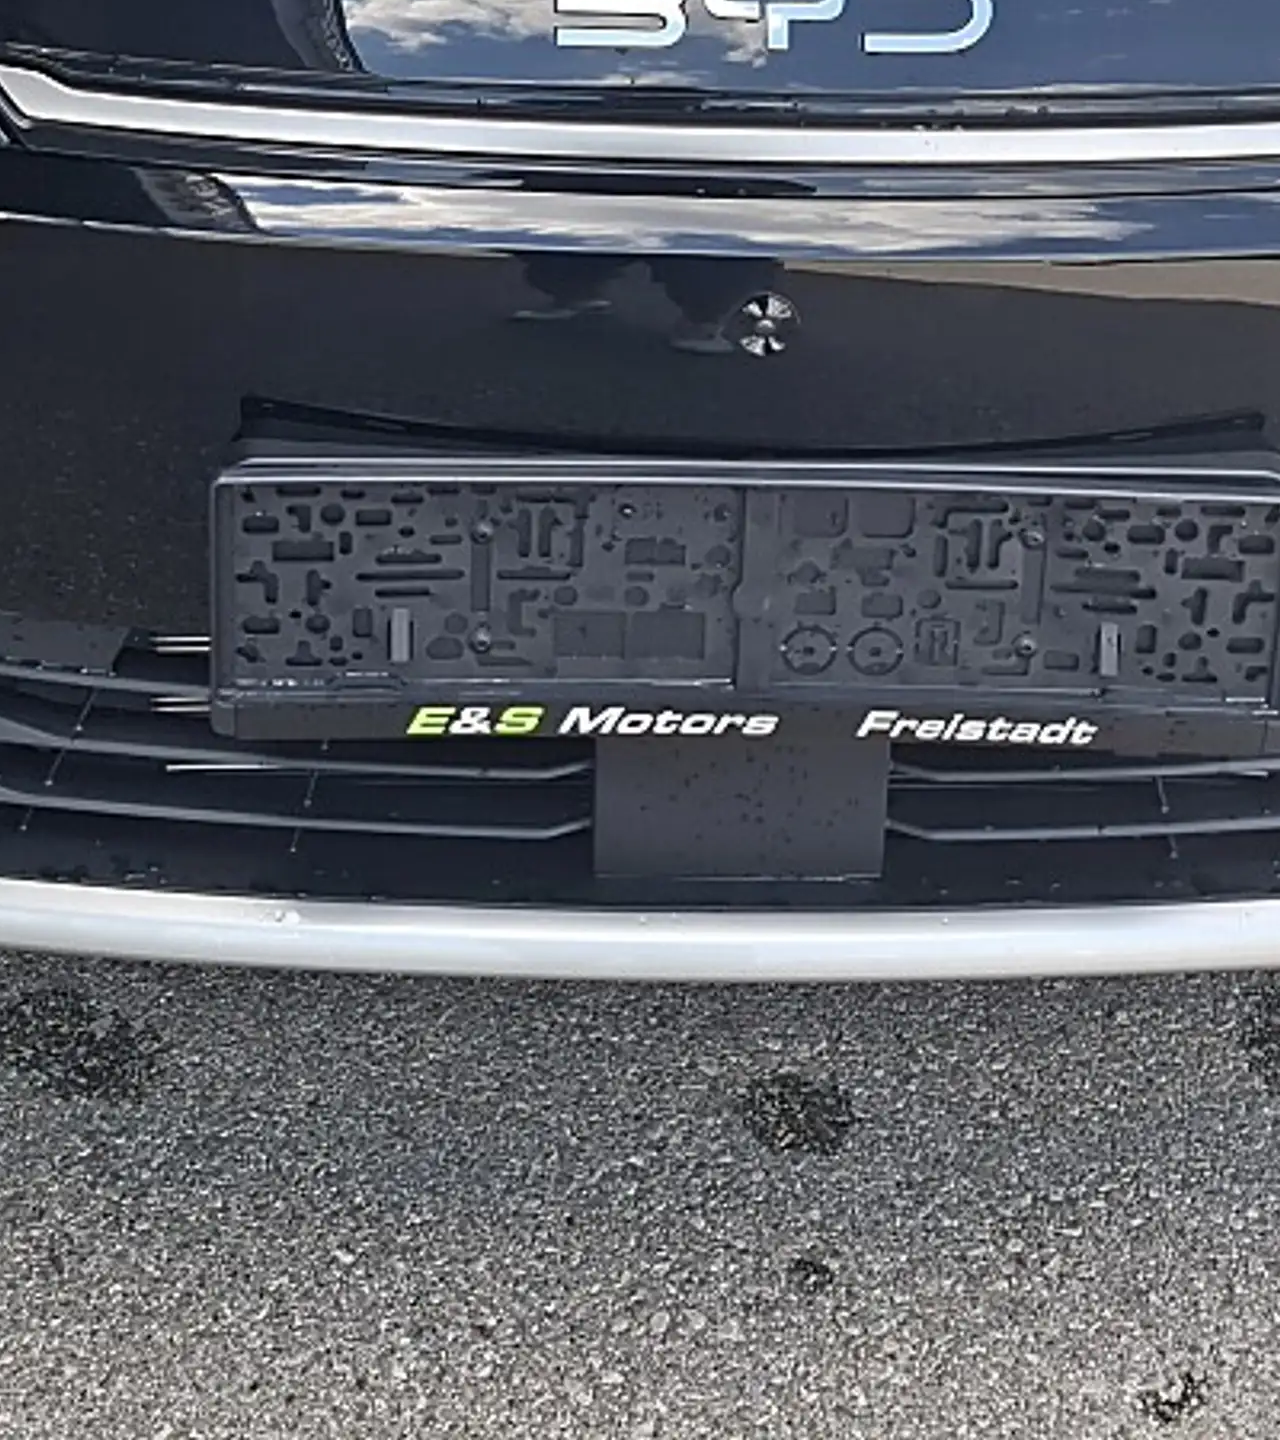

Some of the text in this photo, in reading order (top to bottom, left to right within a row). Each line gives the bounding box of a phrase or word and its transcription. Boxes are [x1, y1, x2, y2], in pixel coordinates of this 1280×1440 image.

[406, 706, 1099, 745] E&S Motors Freistadt
